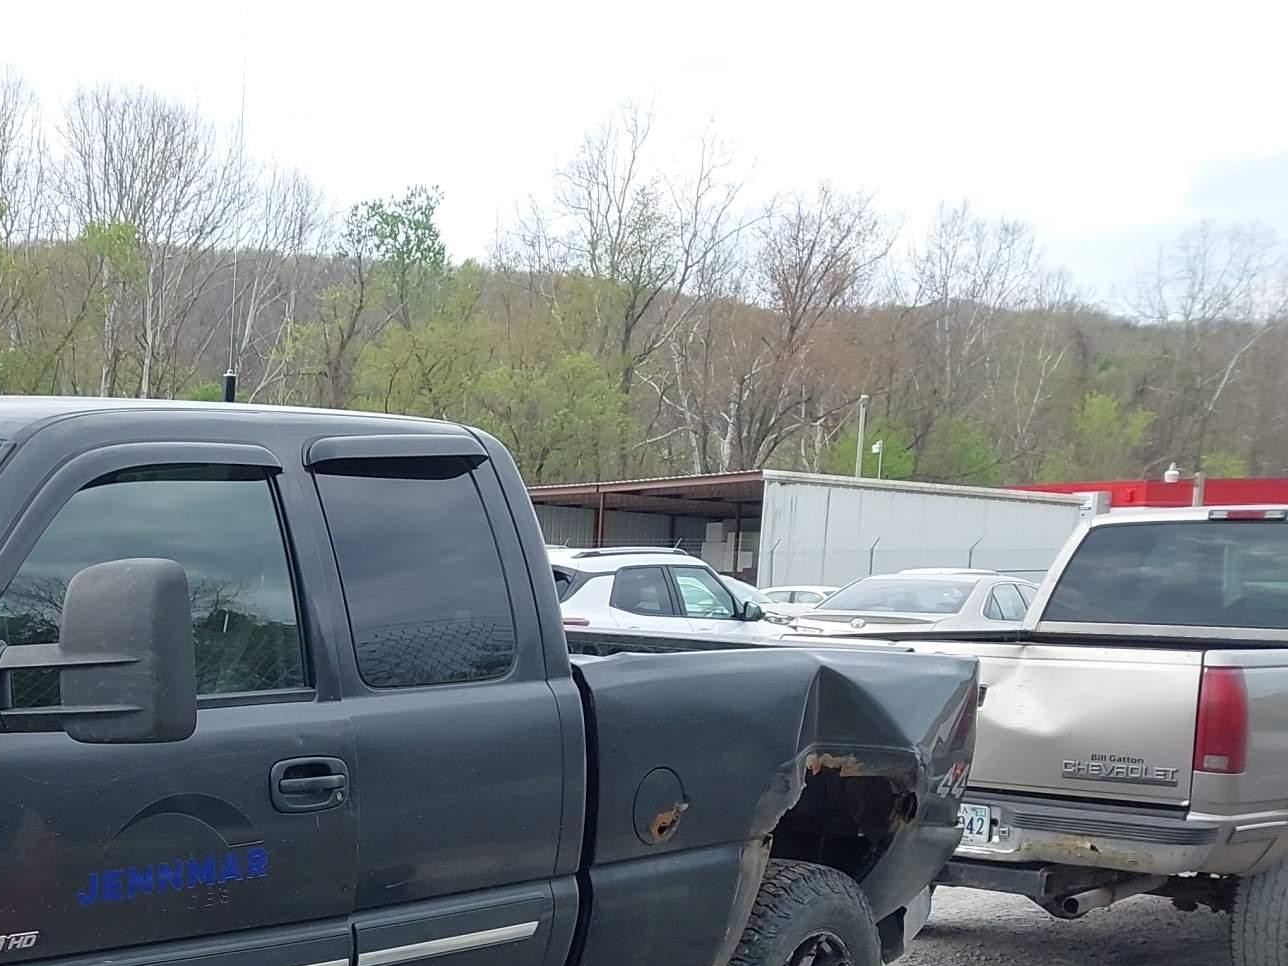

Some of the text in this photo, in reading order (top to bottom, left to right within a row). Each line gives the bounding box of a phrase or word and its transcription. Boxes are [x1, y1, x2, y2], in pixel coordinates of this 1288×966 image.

[1090, 753, 1145, 764] Bill Gatton
[1062, 759, 1178, 783] CHEVROLET
[76, 847, 269, 907] JENNMAR
[7, 934, 38, 951] HD
